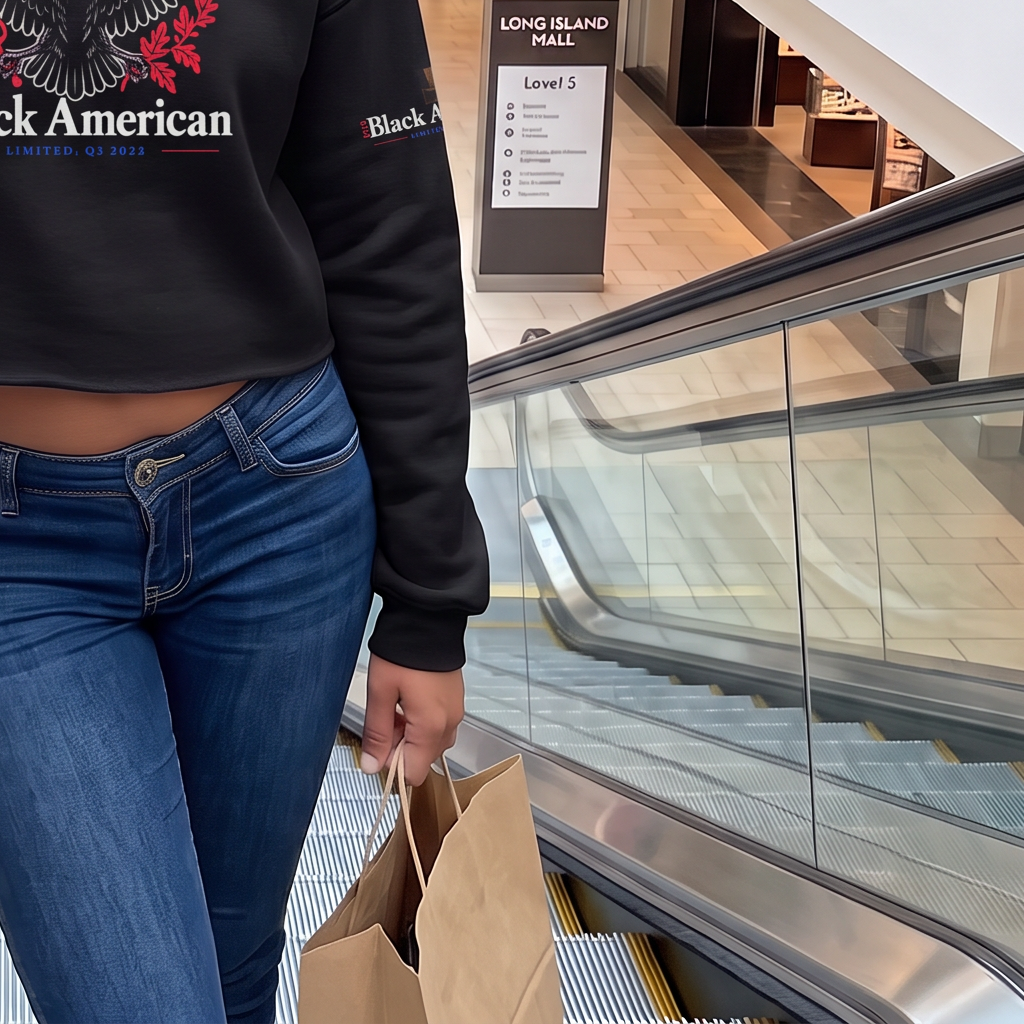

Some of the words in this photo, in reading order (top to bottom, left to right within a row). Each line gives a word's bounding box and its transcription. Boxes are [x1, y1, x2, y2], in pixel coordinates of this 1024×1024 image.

[500, 17, 546, 30] LONG
[550, 16, 609, 30] ISLAND
[532, 33, 575, 46] MALL
[567, 76, 577, 90] 5
[44, 97, 233, 137] American
[366, 107, 427, 138] Black
[85, 145, 104, 158] Q3
